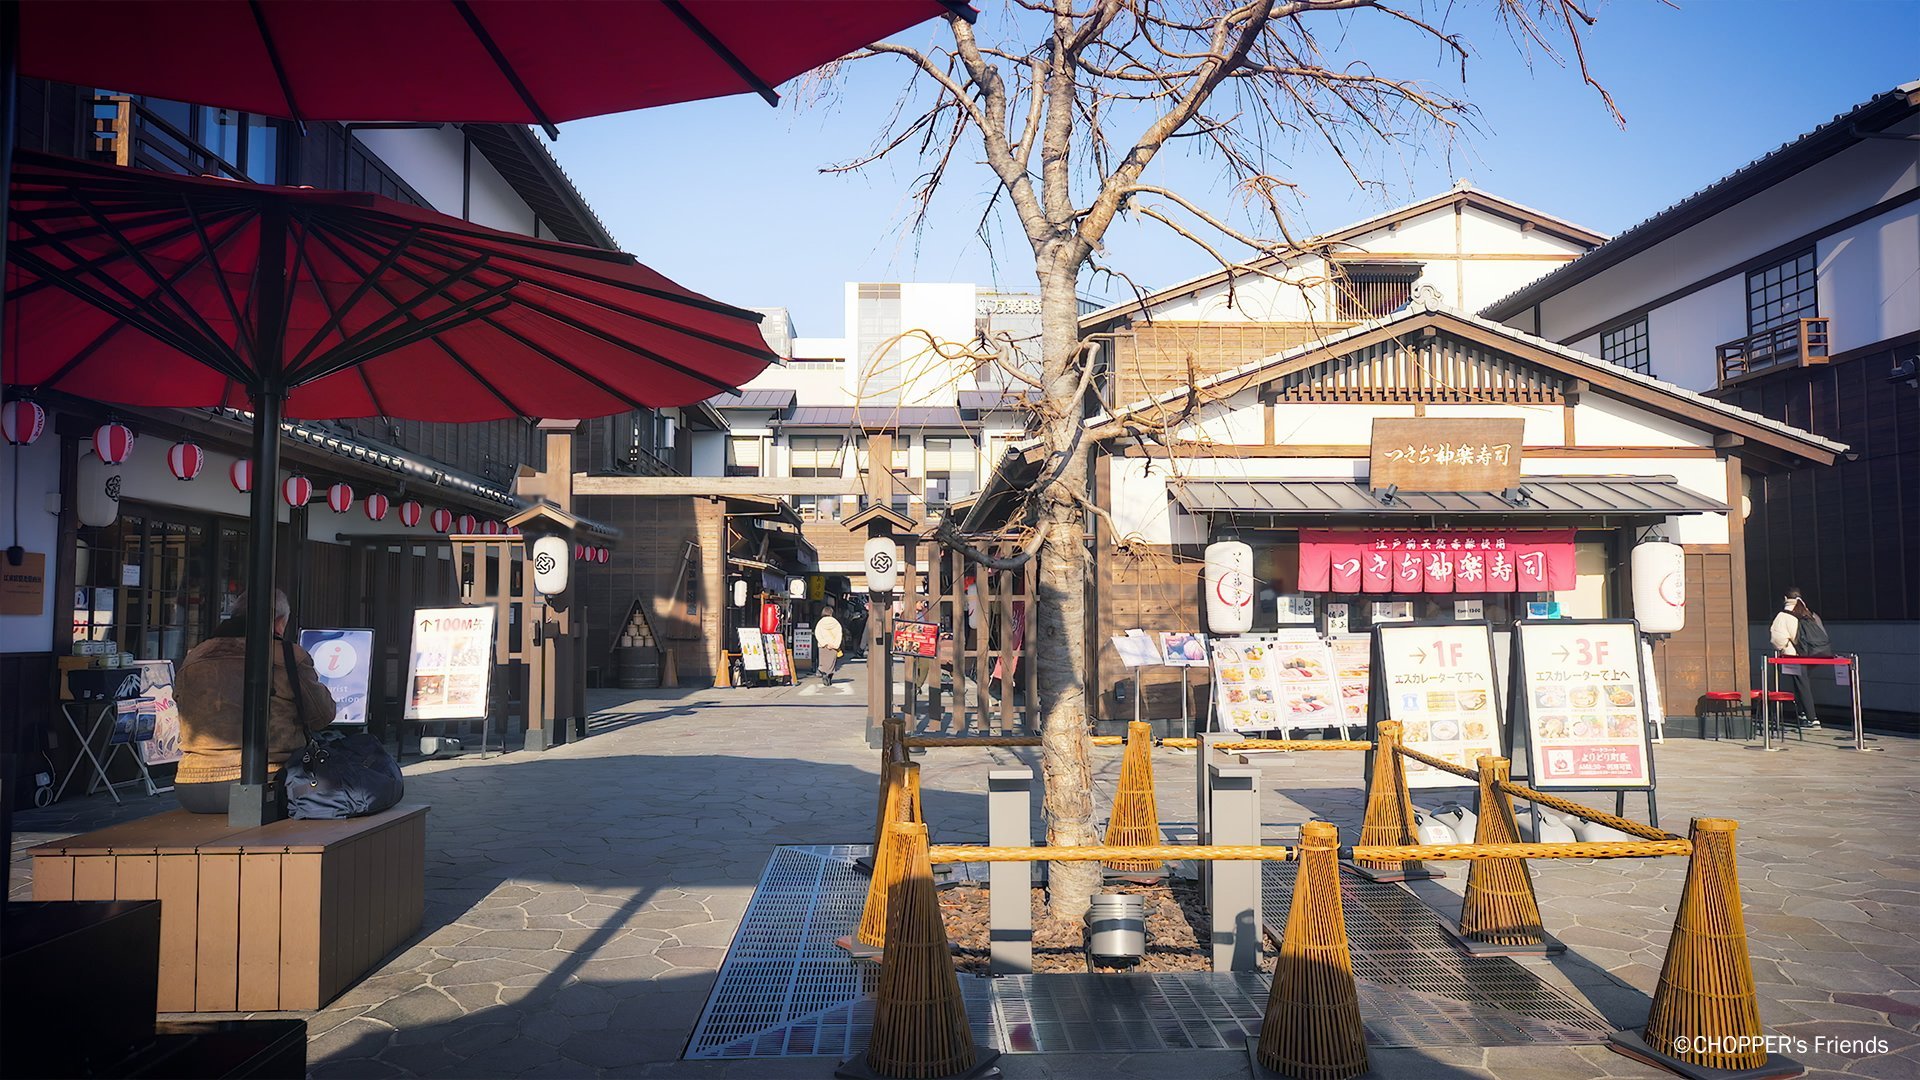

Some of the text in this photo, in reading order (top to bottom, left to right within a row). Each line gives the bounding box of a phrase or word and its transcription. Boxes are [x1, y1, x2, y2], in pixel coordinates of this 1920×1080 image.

[992, 299, 1043, 315] 万葉倶楽
[1384, 442, 1512, 467] つきぢ神楽寿司
[1333, 550, 1545, 582] つきぢ神楽寿司
[1432, 640, 1463, 667] 1F
[1575, 638, 1609, 666] 3F
[1394, 671, 1484, 684] エスカレーターで下へ
[1535, 669, 1630, 682] エスカレーターで上へ
